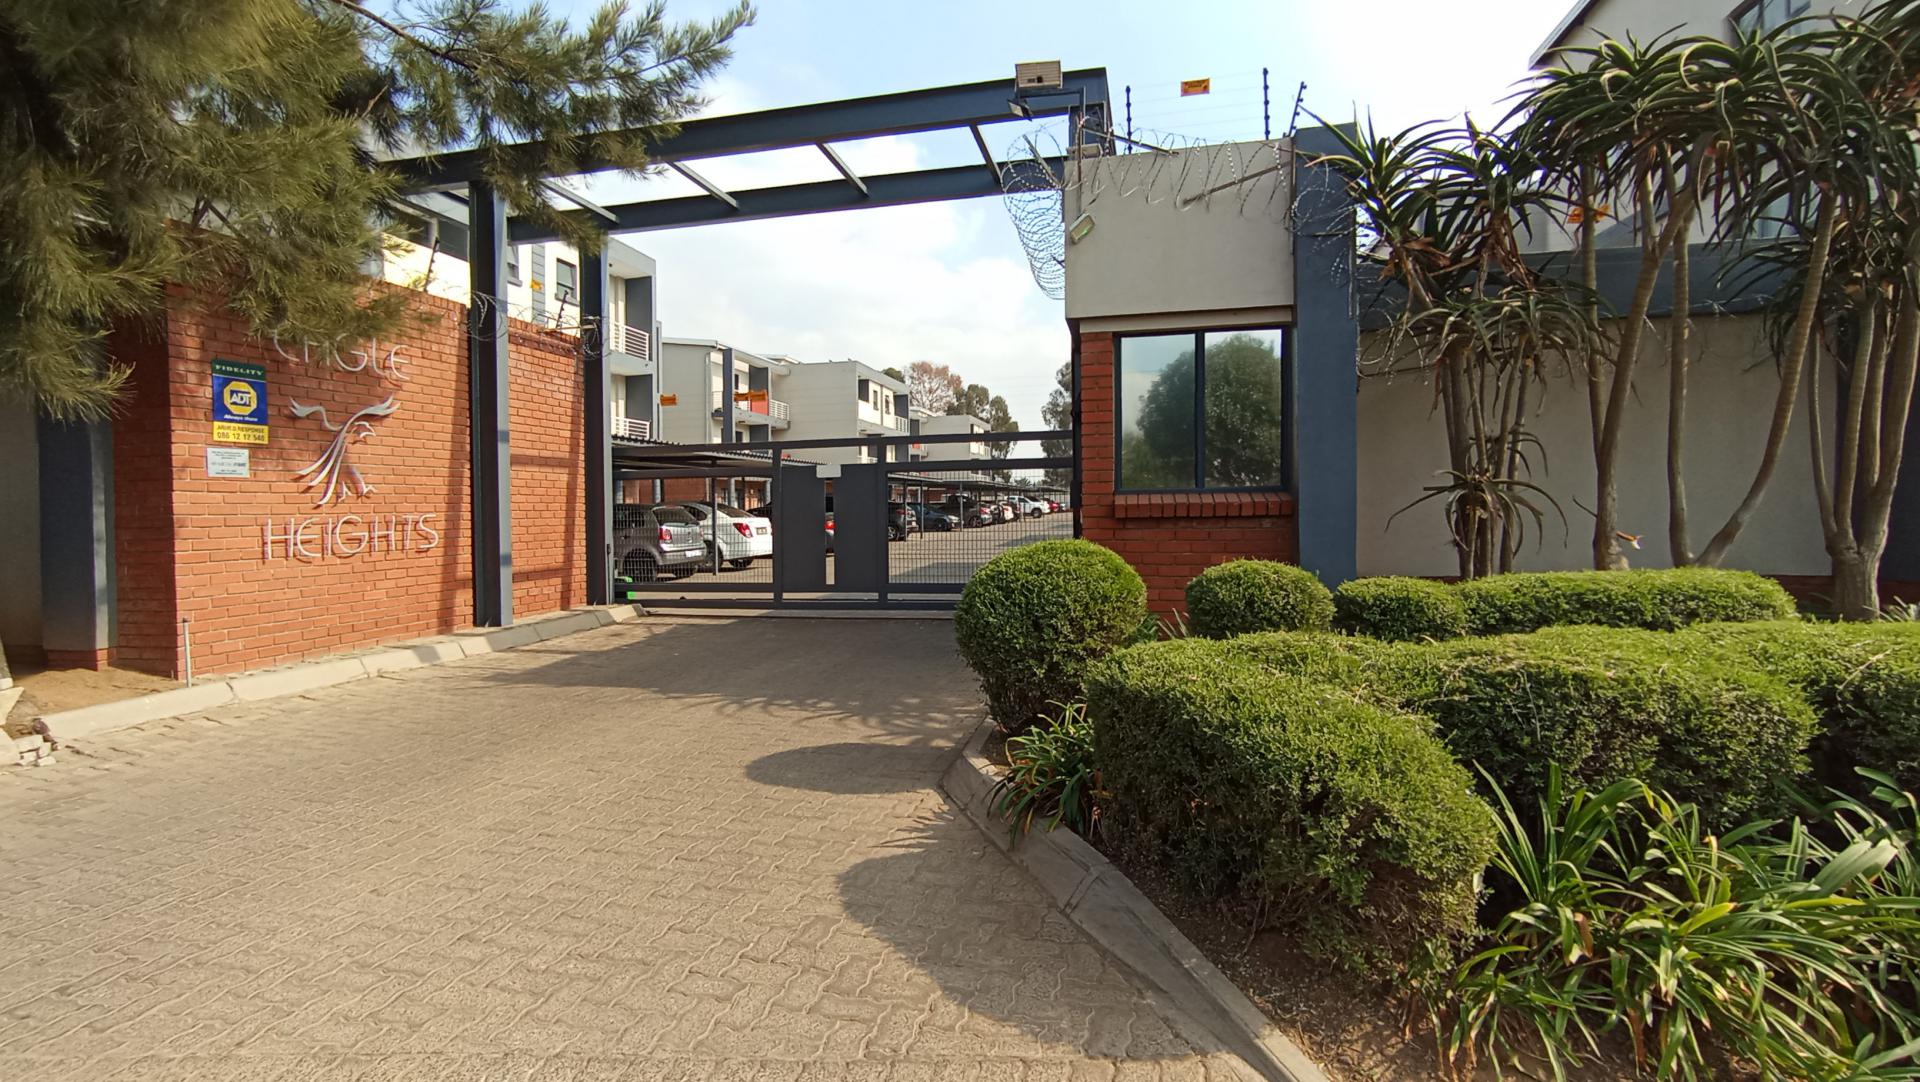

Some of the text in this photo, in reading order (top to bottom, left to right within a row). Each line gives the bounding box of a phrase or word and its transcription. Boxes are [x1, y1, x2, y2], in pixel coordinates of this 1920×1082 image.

[215, 364, 264, 376] FIDELITY
[229, 392, 252, 405] ADT
[266, 513, 439, 560] HEIGHTS
